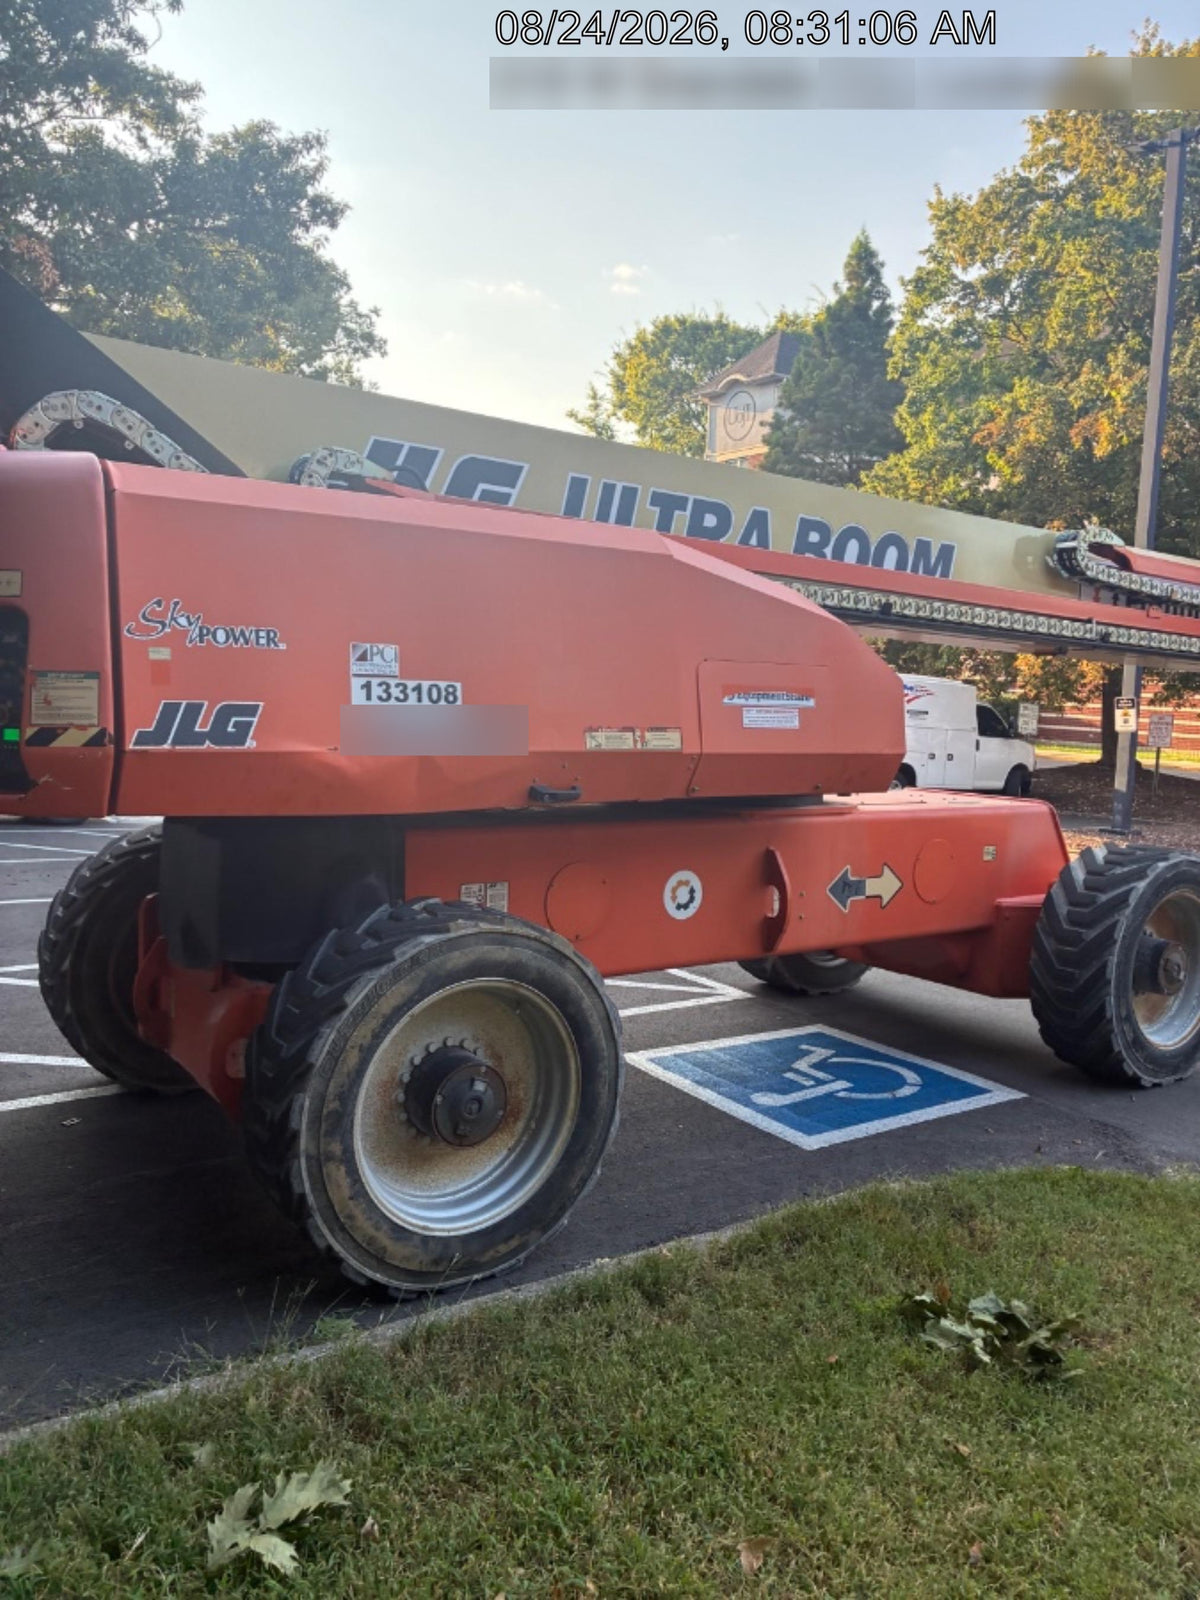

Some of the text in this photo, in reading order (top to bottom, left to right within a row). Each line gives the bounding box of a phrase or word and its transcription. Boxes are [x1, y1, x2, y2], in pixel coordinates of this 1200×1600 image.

[792, 513, 957, 580] BOOM
[360, 680, 459, 704] 133108
[129, 700, 264, 749] JLG
